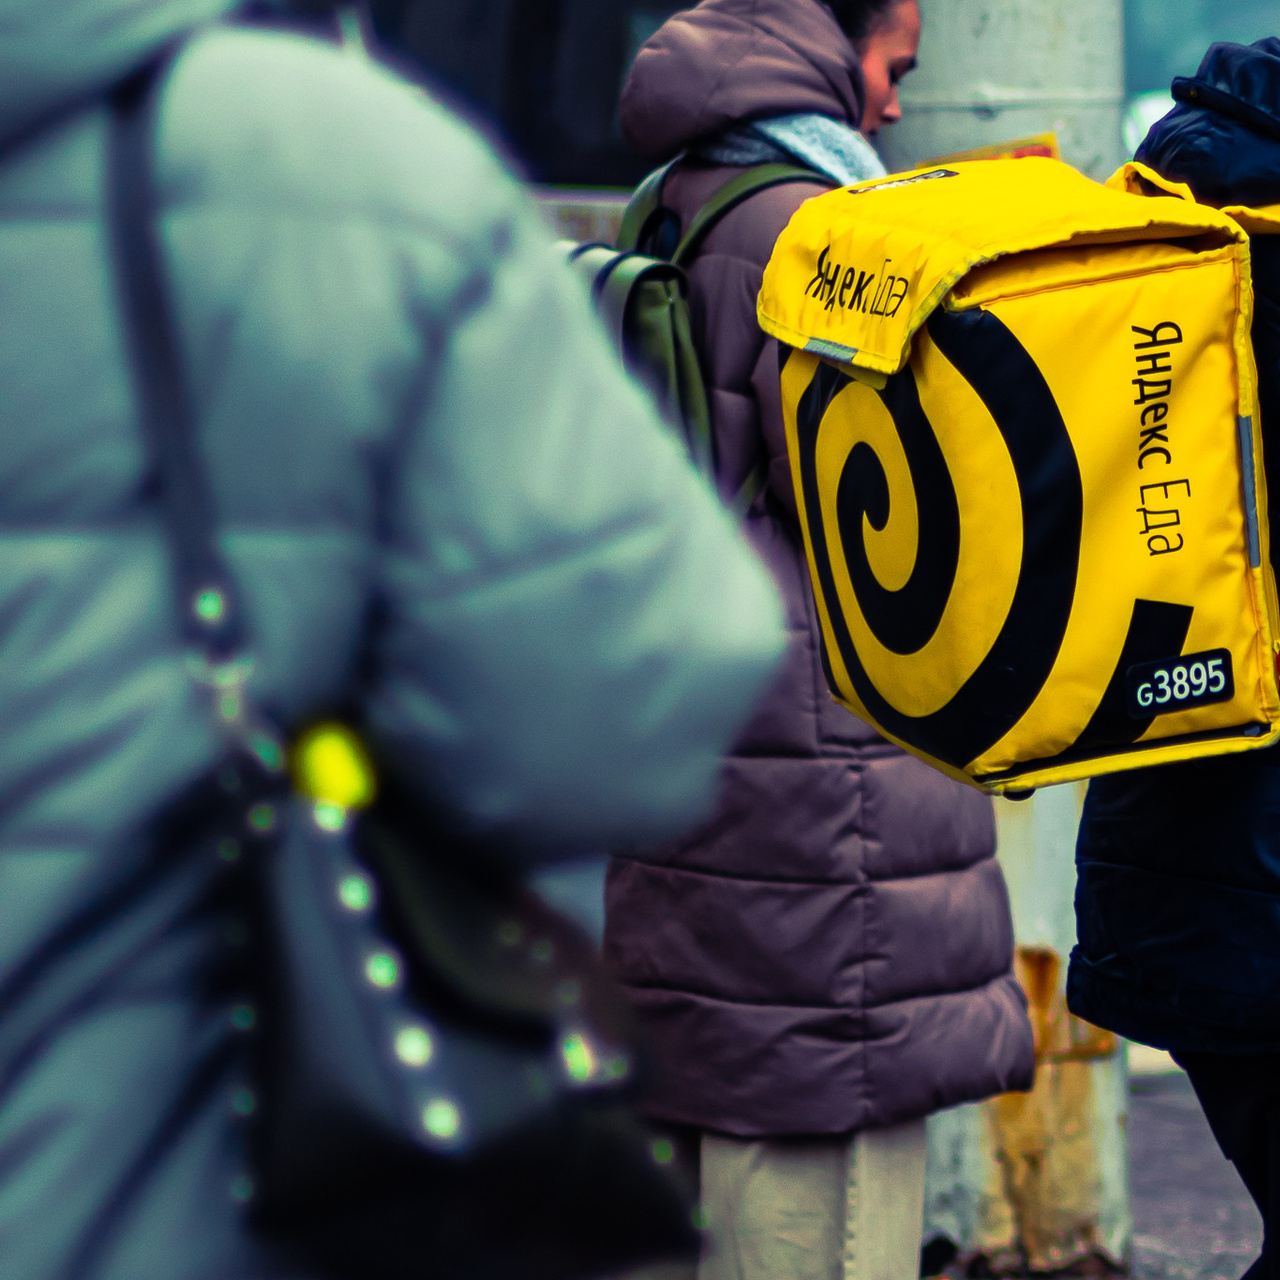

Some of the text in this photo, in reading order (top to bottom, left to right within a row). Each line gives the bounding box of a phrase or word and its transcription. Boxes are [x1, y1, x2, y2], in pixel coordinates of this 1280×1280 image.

[1131, 321, 1192, 556] Яндекс Еда
[1136, 658, 1226, 707] G3895
